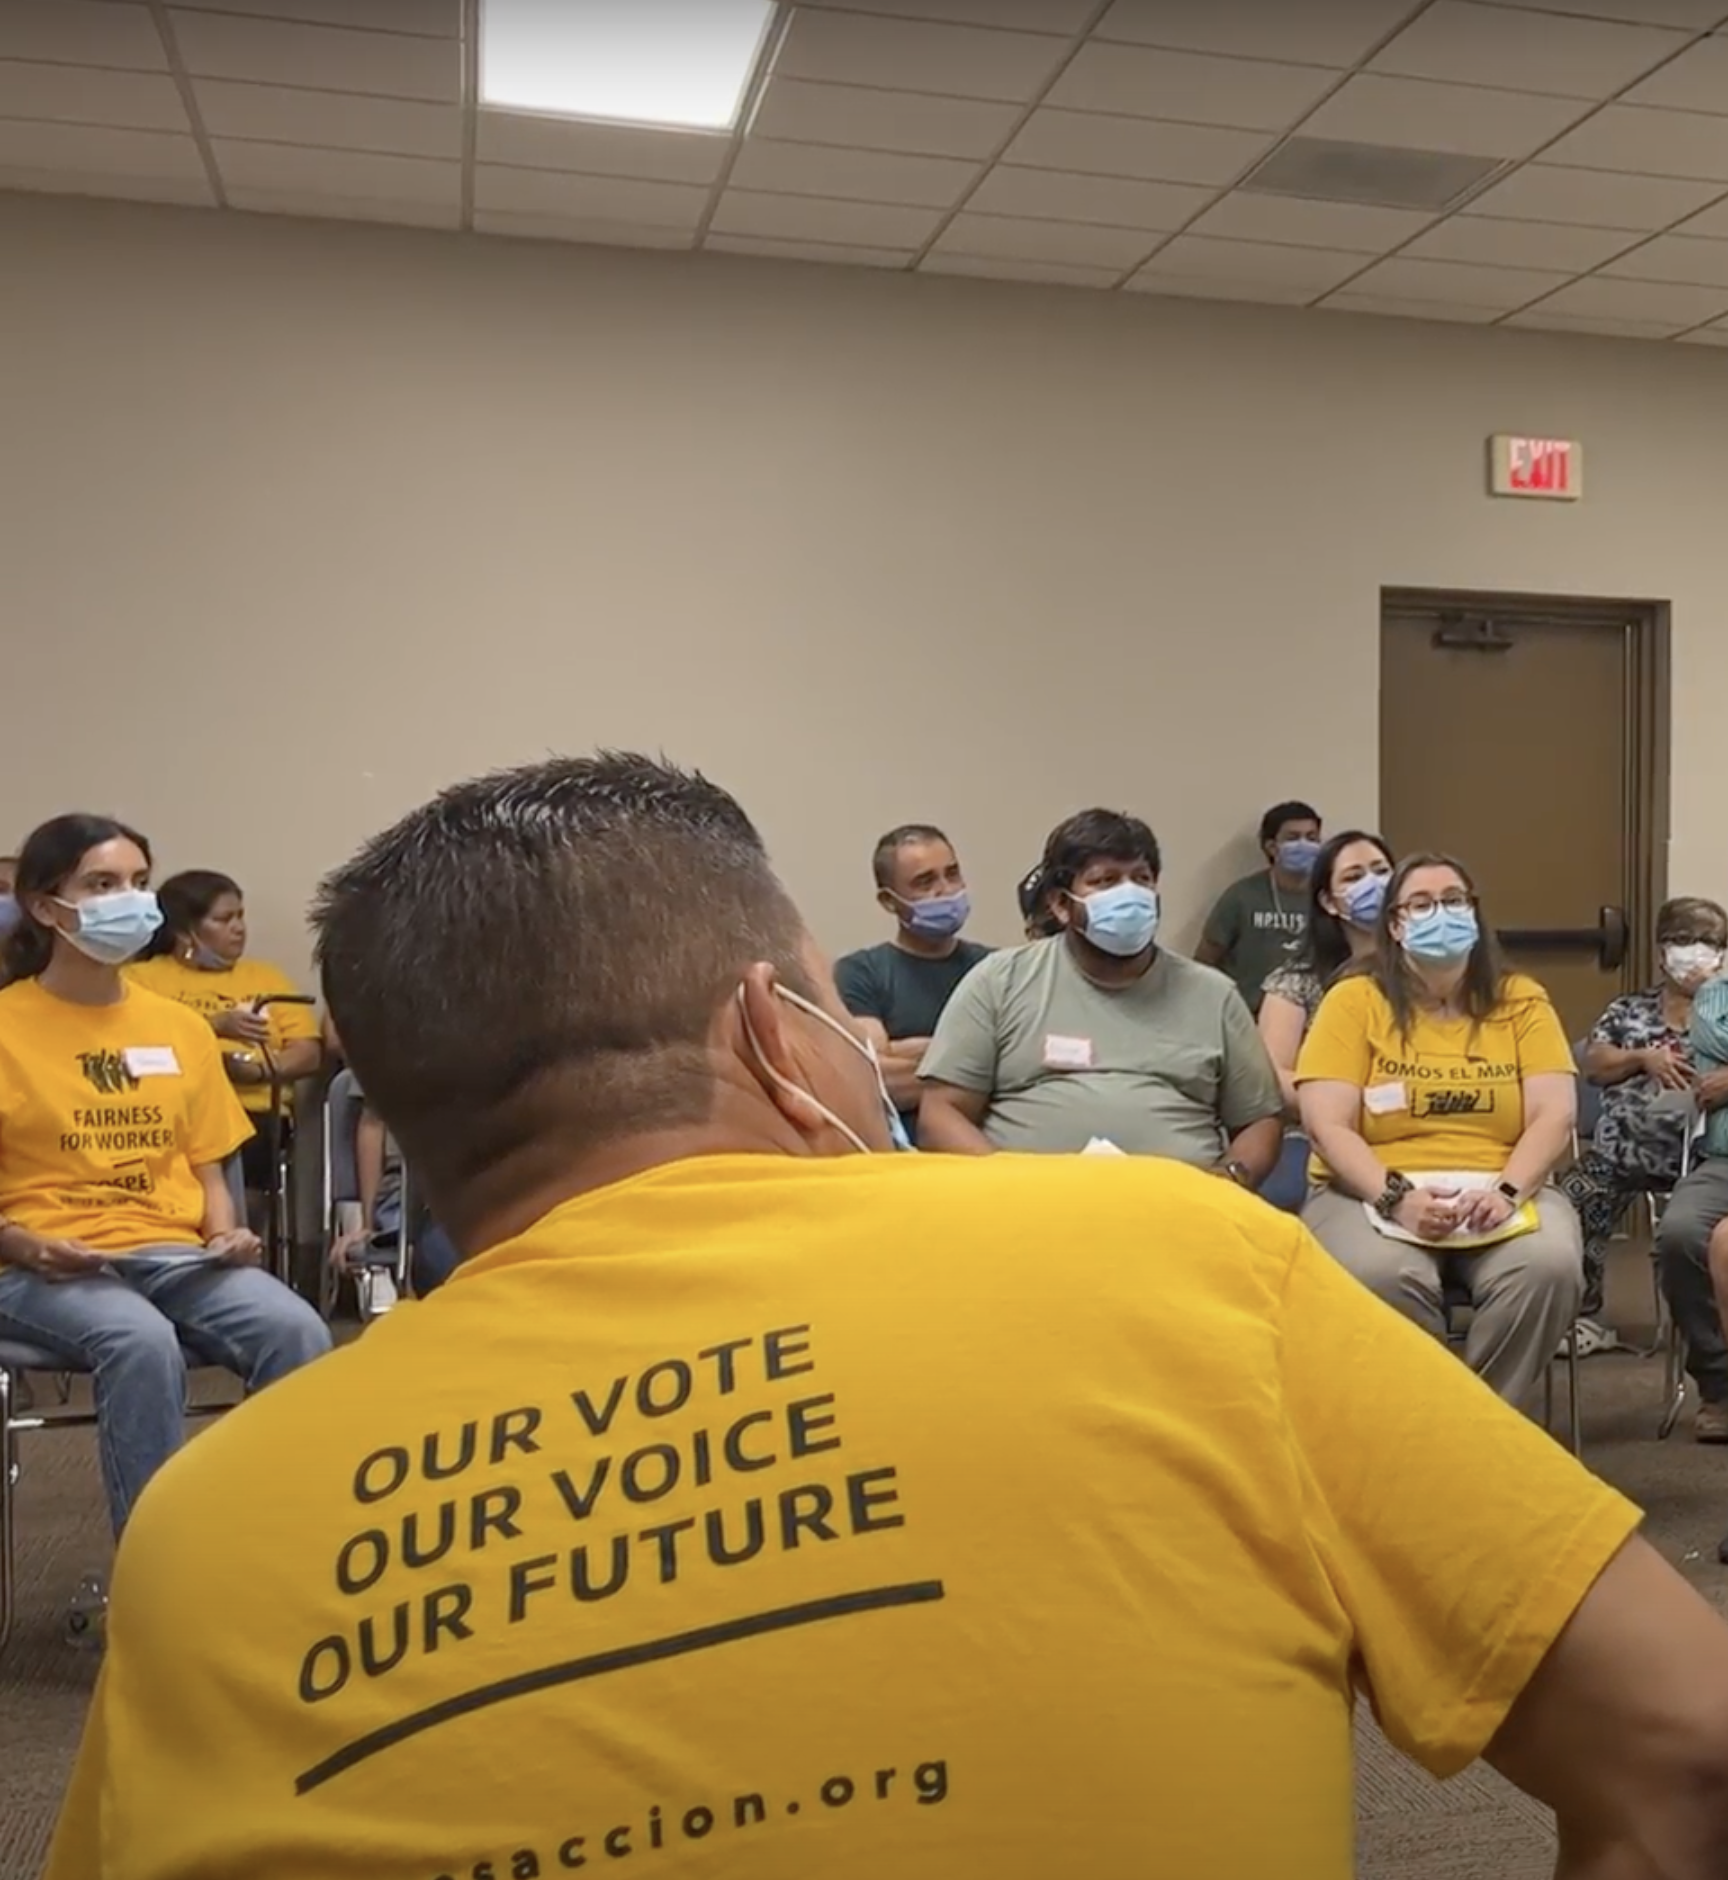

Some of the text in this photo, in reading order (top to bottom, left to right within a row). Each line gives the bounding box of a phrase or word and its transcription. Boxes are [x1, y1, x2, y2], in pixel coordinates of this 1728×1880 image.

[1510, 438, 1571, 491] EXIT
[1377, 1057, 1443, 1079] SOMOS
[1450, 1066, 1471, 1080] EL
[60, 1132, 92, 1152] FOR
[73, 1106, 163, 1128] FAIRNESS
[353, 1324, 815, 1504] OUR VOTE
[335, 1393, 842, 1596] OUR VOICE
[298, 1466, 906, 1703] OUR FUTURE
[433, 1757, 950, 1880] saccion.org
